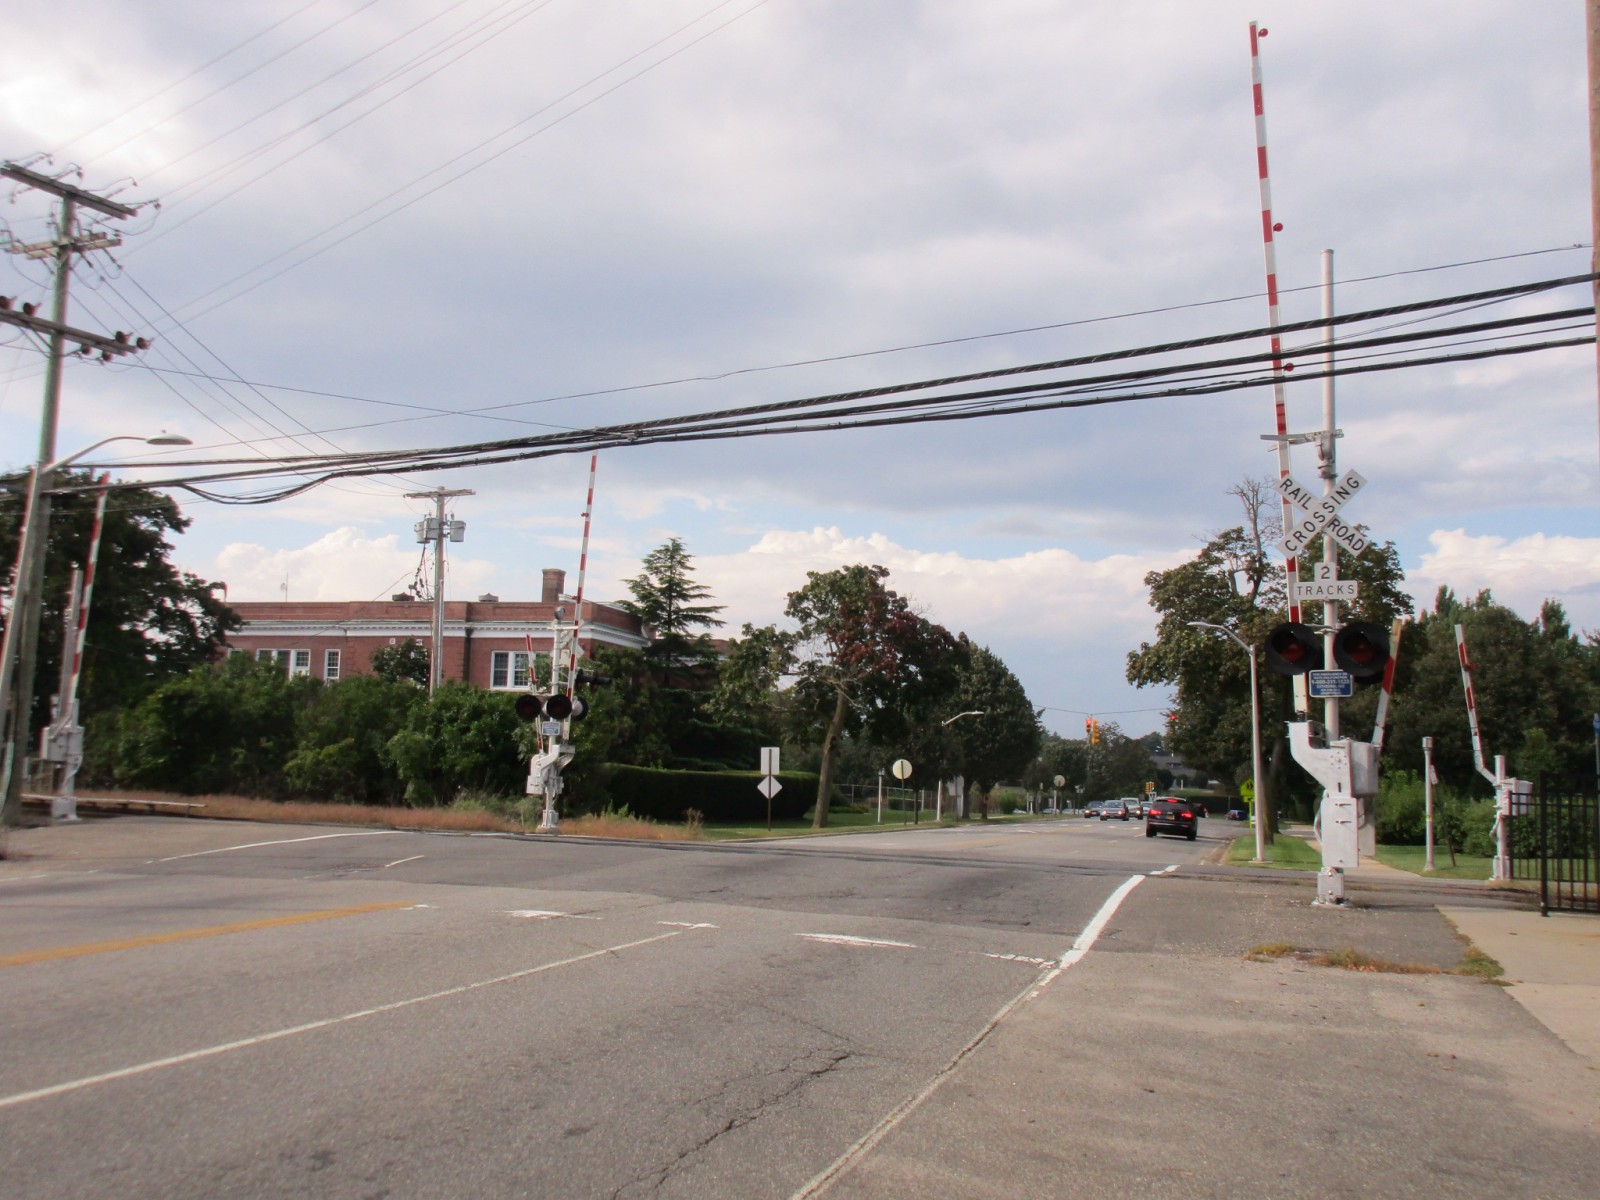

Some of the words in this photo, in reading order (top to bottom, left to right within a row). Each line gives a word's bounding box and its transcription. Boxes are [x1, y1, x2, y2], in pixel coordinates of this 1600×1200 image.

[1280, 478, 1311, 510] RAIL
[1328, 518, 1364, 551] ROAD
[1285, 477, 1359, 552] CROSSING
[1297, 585, 1355, 596] TRACKS
[1321, 566, 1330, 579] 2
